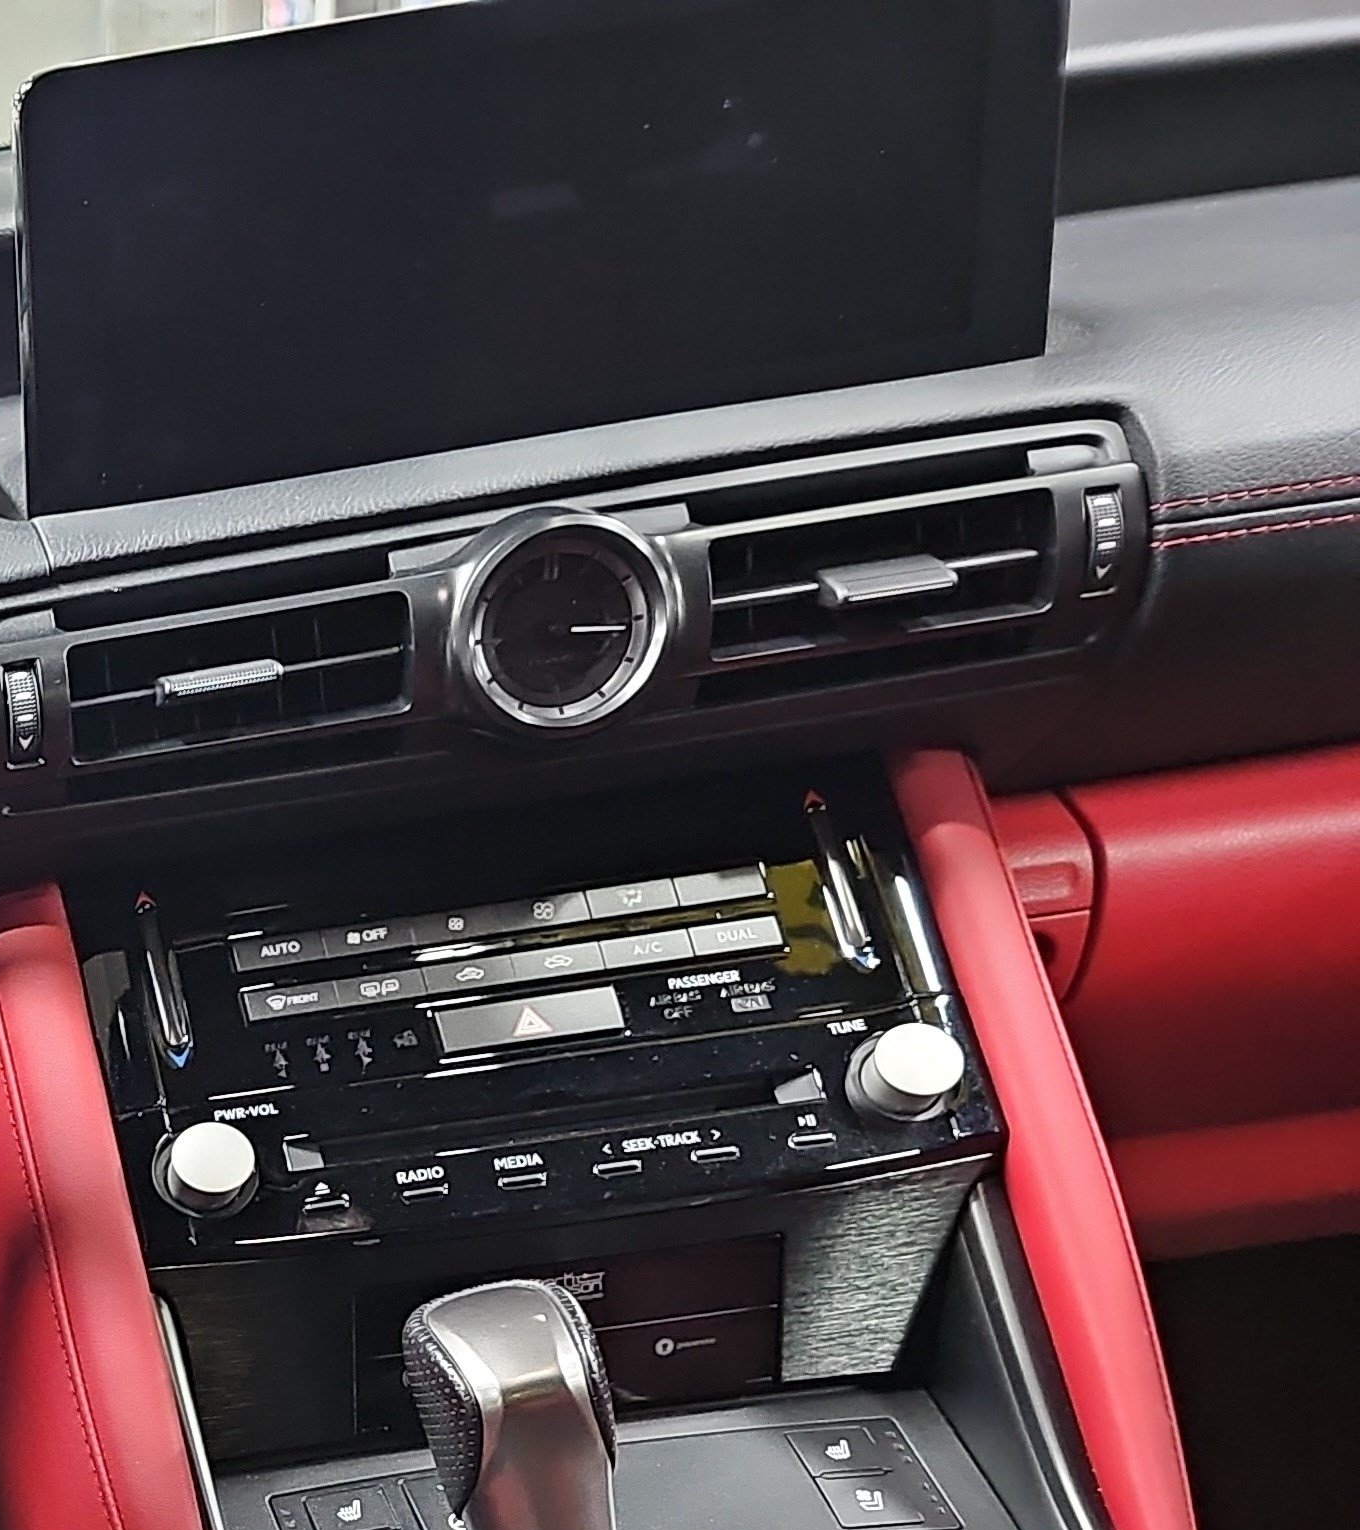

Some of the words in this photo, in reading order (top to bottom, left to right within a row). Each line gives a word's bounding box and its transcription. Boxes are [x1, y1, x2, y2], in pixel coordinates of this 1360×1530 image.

[361, 926, 389, 943] OFF
[716, 928, 758, 944] DUAL
[259, 940, 301, 958] AUTO
[633, 941, 663, 956] A/C
[667, 969, 741, 990] PASSENGER
[827, 1018, 868, 1036] TUNE
[493, 1152, 544, 1171] MEDIA
[395, 1165, 445, 1185] RADIO
